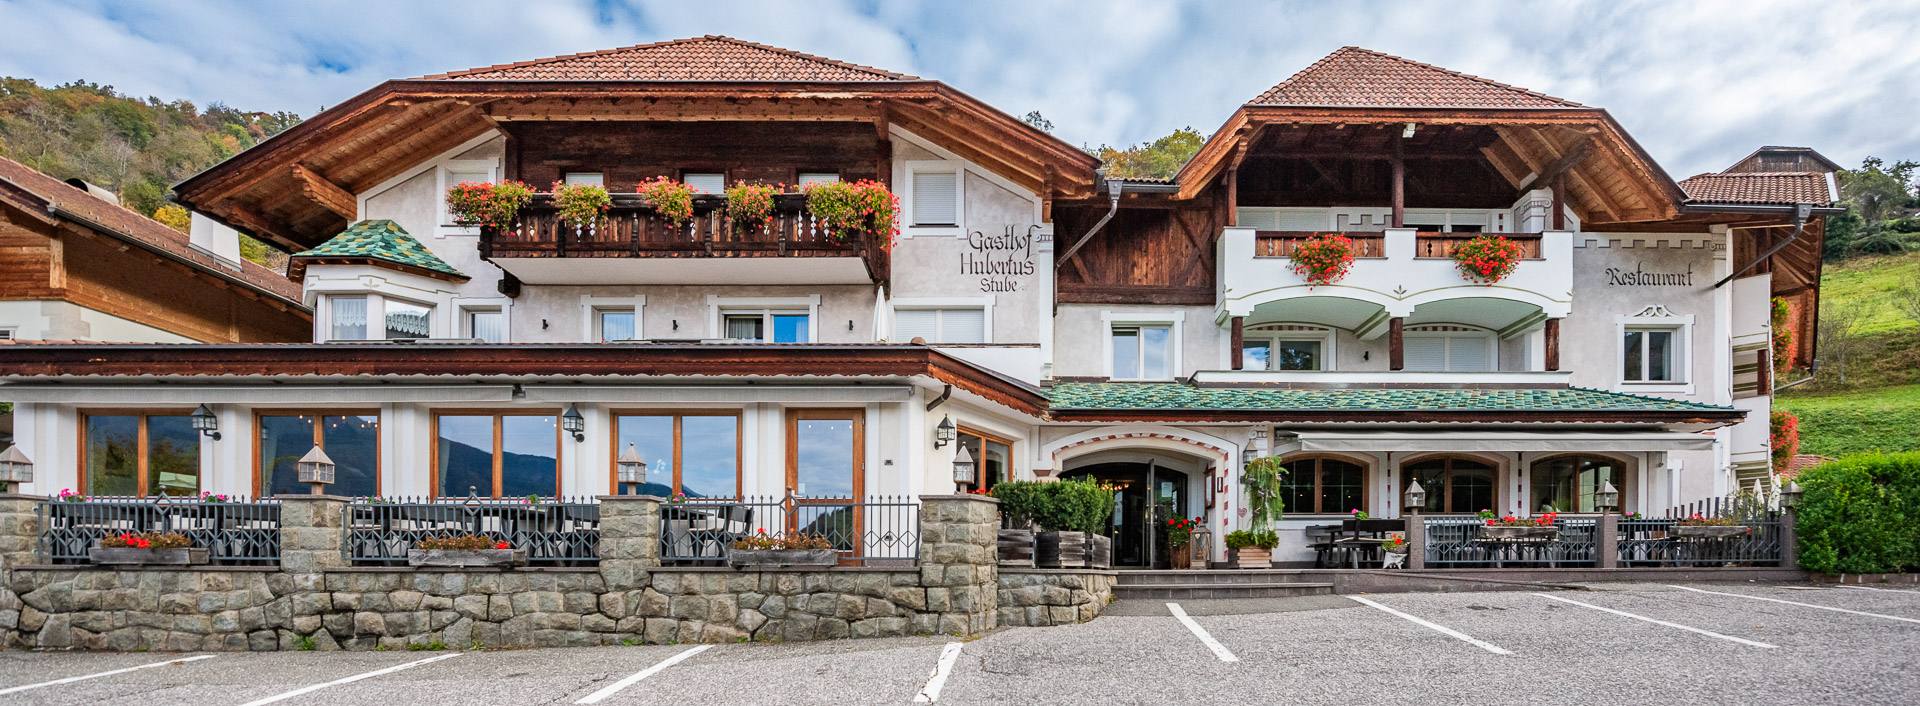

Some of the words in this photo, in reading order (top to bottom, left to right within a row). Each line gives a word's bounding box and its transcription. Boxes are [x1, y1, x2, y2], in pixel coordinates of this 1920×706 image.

[969, 224, 1042, 260] Gasthof
[960, 251, 1034, 275] Hubertus
[1605, 261, 1692, 286] Restaurant
[980, 276, 1018, 292] Stube
